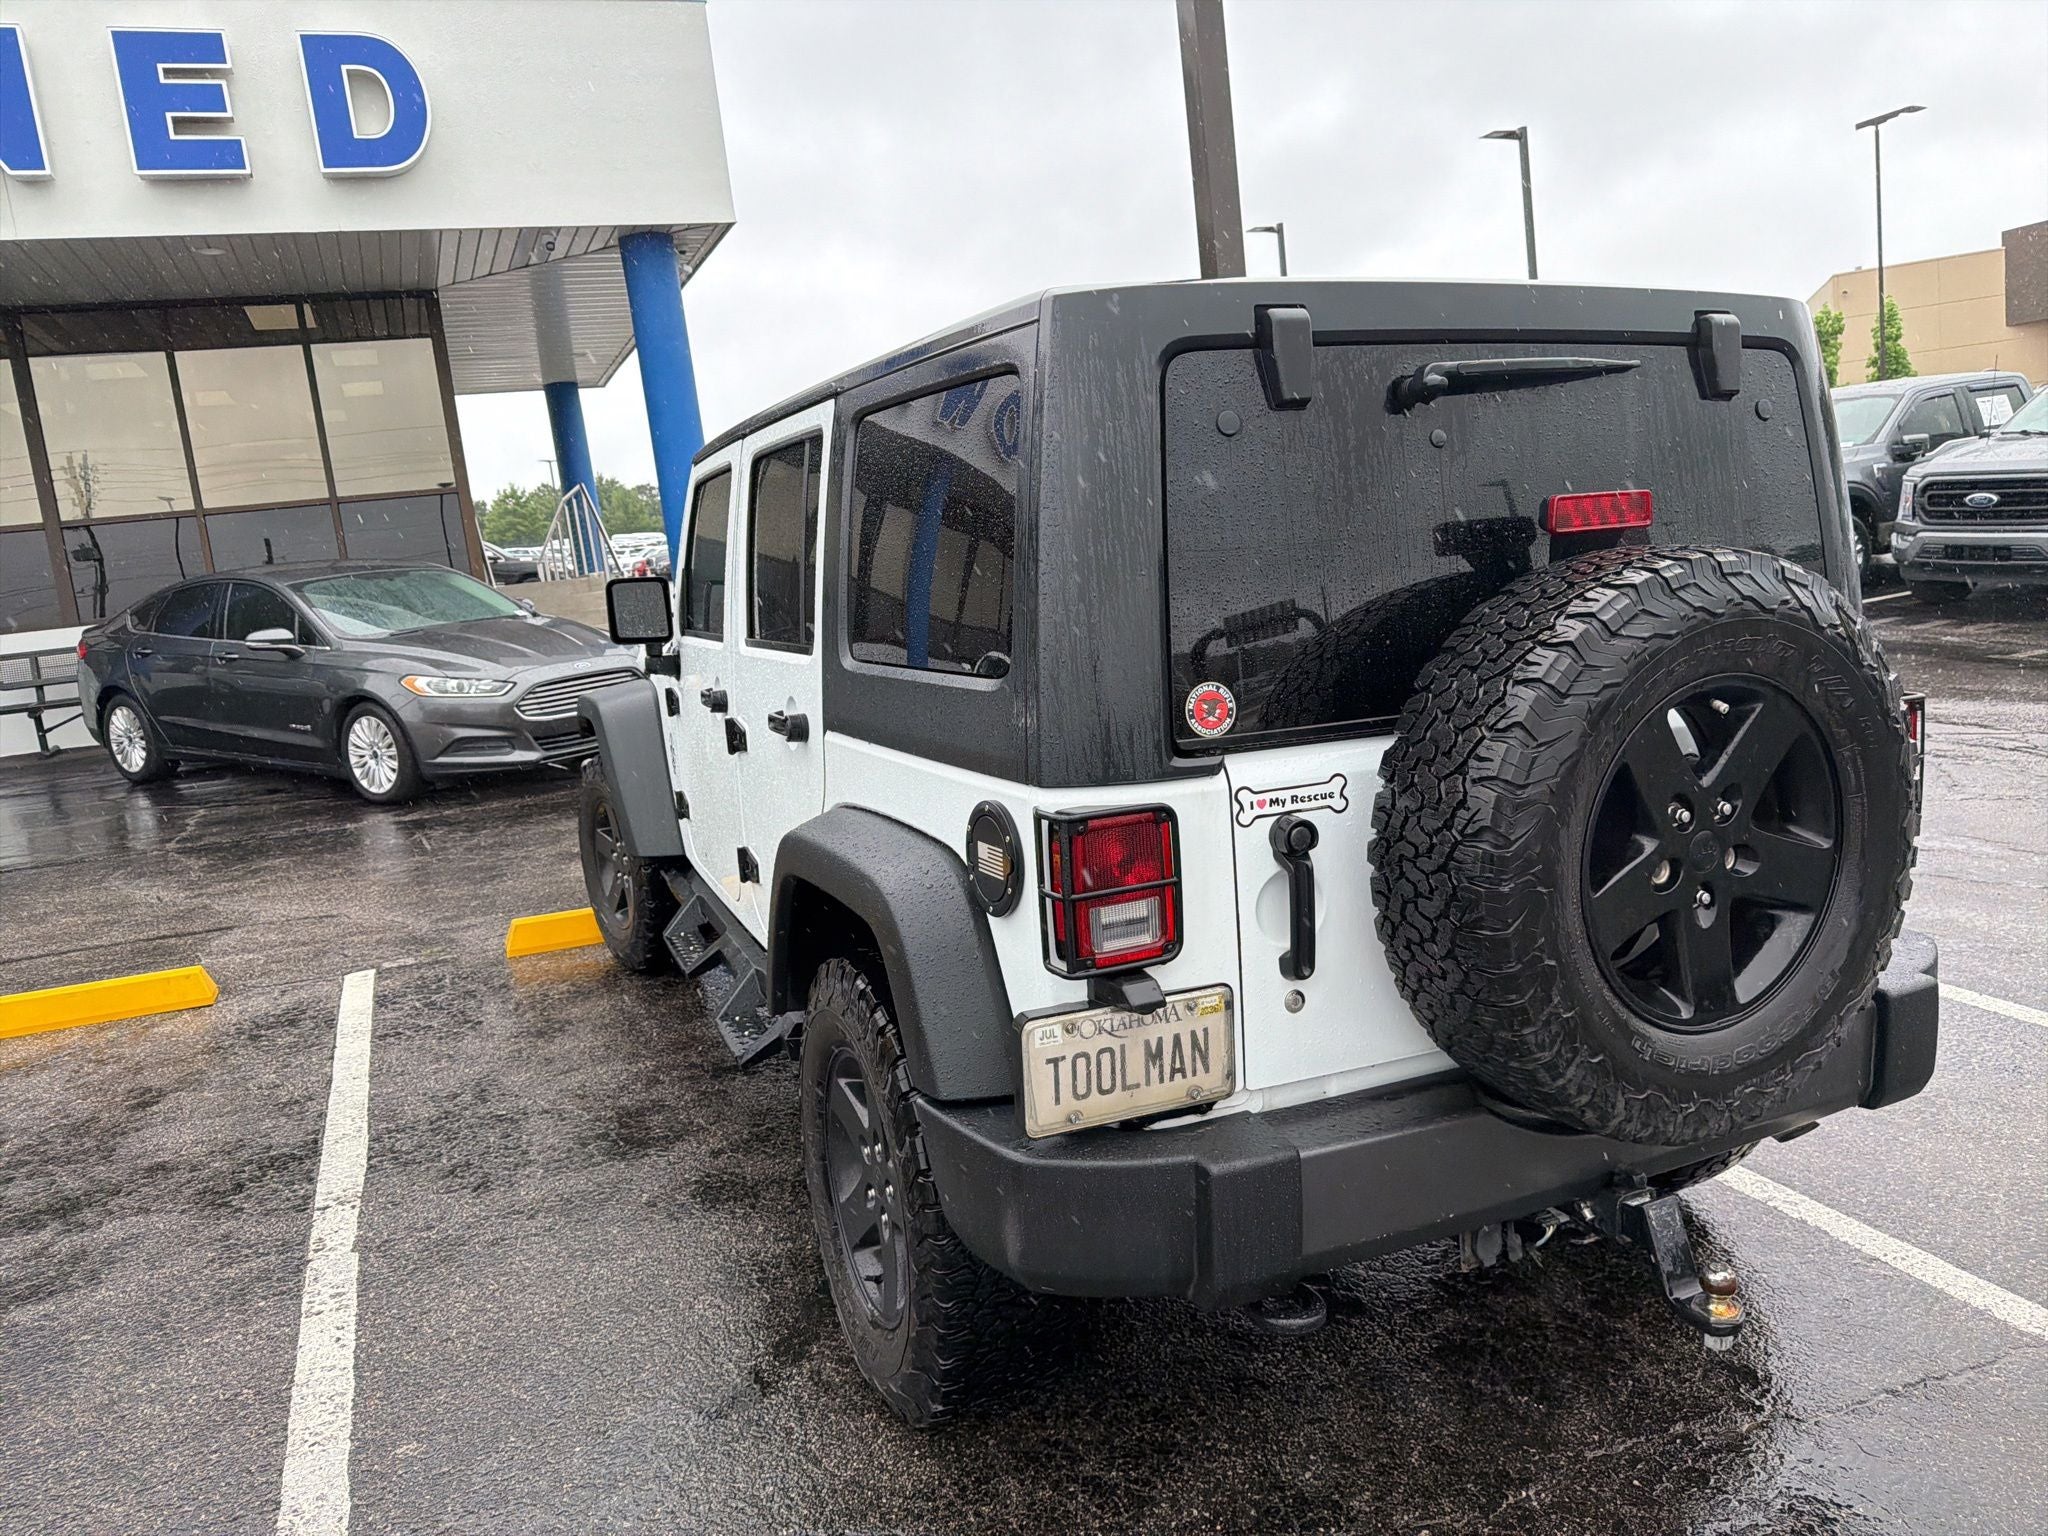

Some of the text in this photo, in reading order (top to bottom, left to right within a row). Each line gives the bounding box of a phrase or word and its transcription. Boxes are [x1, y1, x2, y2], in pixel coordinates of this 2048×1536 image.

[1188, 684, 1233, 709] NATIONAL RIFLE
[1190, 717, 1232, 735] ASSOCIATION
[1250, 791, 1335, 810] I My Rescue
[1039, 1028, 1058, 1041] JUL
